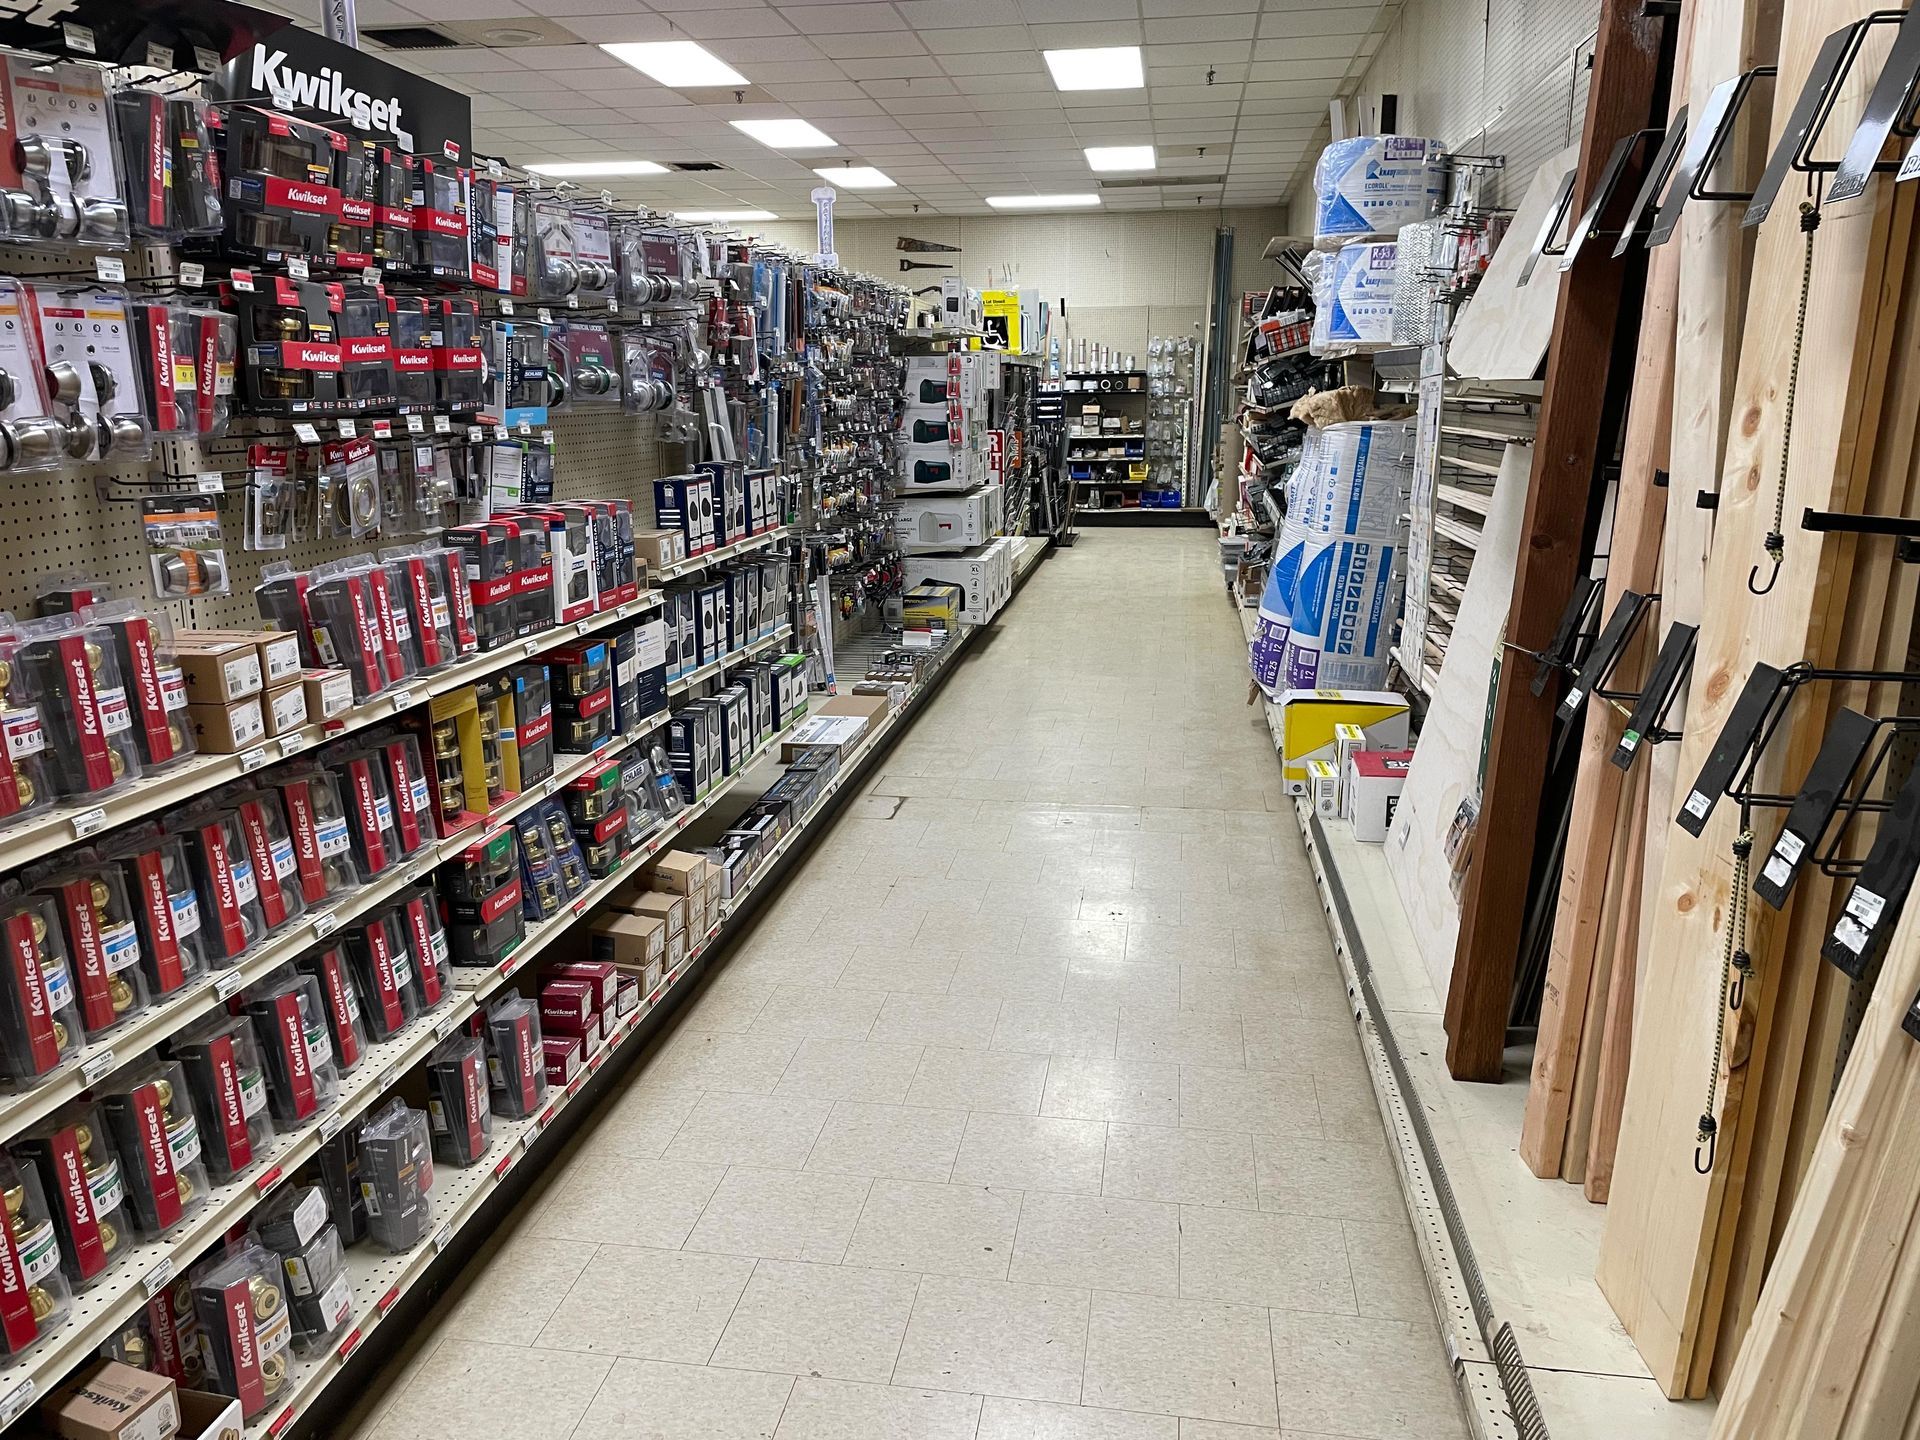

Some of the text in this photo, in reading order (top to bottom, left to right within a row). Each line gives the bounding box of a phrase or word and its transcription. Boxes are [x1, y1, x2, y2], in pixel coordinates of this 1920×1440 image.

[251, 43, 402, 136] Kwikset
[153, 115, 162, 181] Kwikset
[1387, 138, 1406, 150] R-13
[287, 188, 328, 205] Kwikset
[342, 203, 371, 216] Kwikset
[389, 212, 409, 224] Kwikset
[435, 216, 462, 230] Kwikset
[154, 324, 169, 387] Kwikset
[202, 337, 214, 395] Kwikset
[302, 349, 341, 364] Kwikse
[351, 343, 386, 355] Kwikset
[400, 355, 428, 365] Kwikset
[453, 354, 477, 364] Kwikset
[348, 444, 371, 461] Kwikset
[1356, 456, 1366, 478] INSTALL
[1352, 489, 1361, 501] HOW
[414, 574, 431, 628] Kwikset
[450, 566, 464, 618] Kwikset
[490, 581, 512, 597] Kwikset
[521, 572, 549, 587] Kwikset
[1331, 575, 1346, 620] TOOLS YOU NEED
[1371, 581, 1386, 624] SPECIFICATIONS
[355, 594, 371, 652] Kwikset
[377, 585, 393, 641] Kwikset
[1266, 660, 1278, 684] 116.25
[1273, 643, 1283, 653] 12
[72, 658, 97, 735] Kwikset
[135, 640, 159, 711] Kwikset
[1304, 670, 1315, 680] 12
[590, 695, 607, 708] Kwikset
[525, 722, 548, 739] Kwikset
[395, 759, 412, 812] Kwikset
[623, 765, 644, 784] SCHLAGE
[293, 799, 314, 859] Kwikset
[358, 776, 376, 832] Kwikset
[605, 815, 624, 833] Kwikset
[250, 819, 273, 881] Kwikset
[211, 844, 234, 909] Kwikset
[494, 890, 517, 910] Kwikset
[148, 872, 171, 942] Kwikset
[76, 903, 100, 976] Kwikset
[375, 937, 393, 992] Kwikset
[414, 914, 432, 967] Kwikset
[19, 939, 45, 1016] Kwikset
[330, 968, 348, 1025] Kwikset
[544, 1008, 578, 1017] Kwikset
[286, 1015, 306, 1077] Kwikset
[519, 1028, 532, 1078] Kwikset
[220, 1060, 240, 1126] Kwikset
[467, 1072, 478, 1124] Kwikset
[144, 1105, 168, 1176] Kwikset
[63, 1150, 90, 1225] Kwikset
[155, 1294, 175, 1361] Kwikset
[234, 1301, 253, 1368] Kwikset
